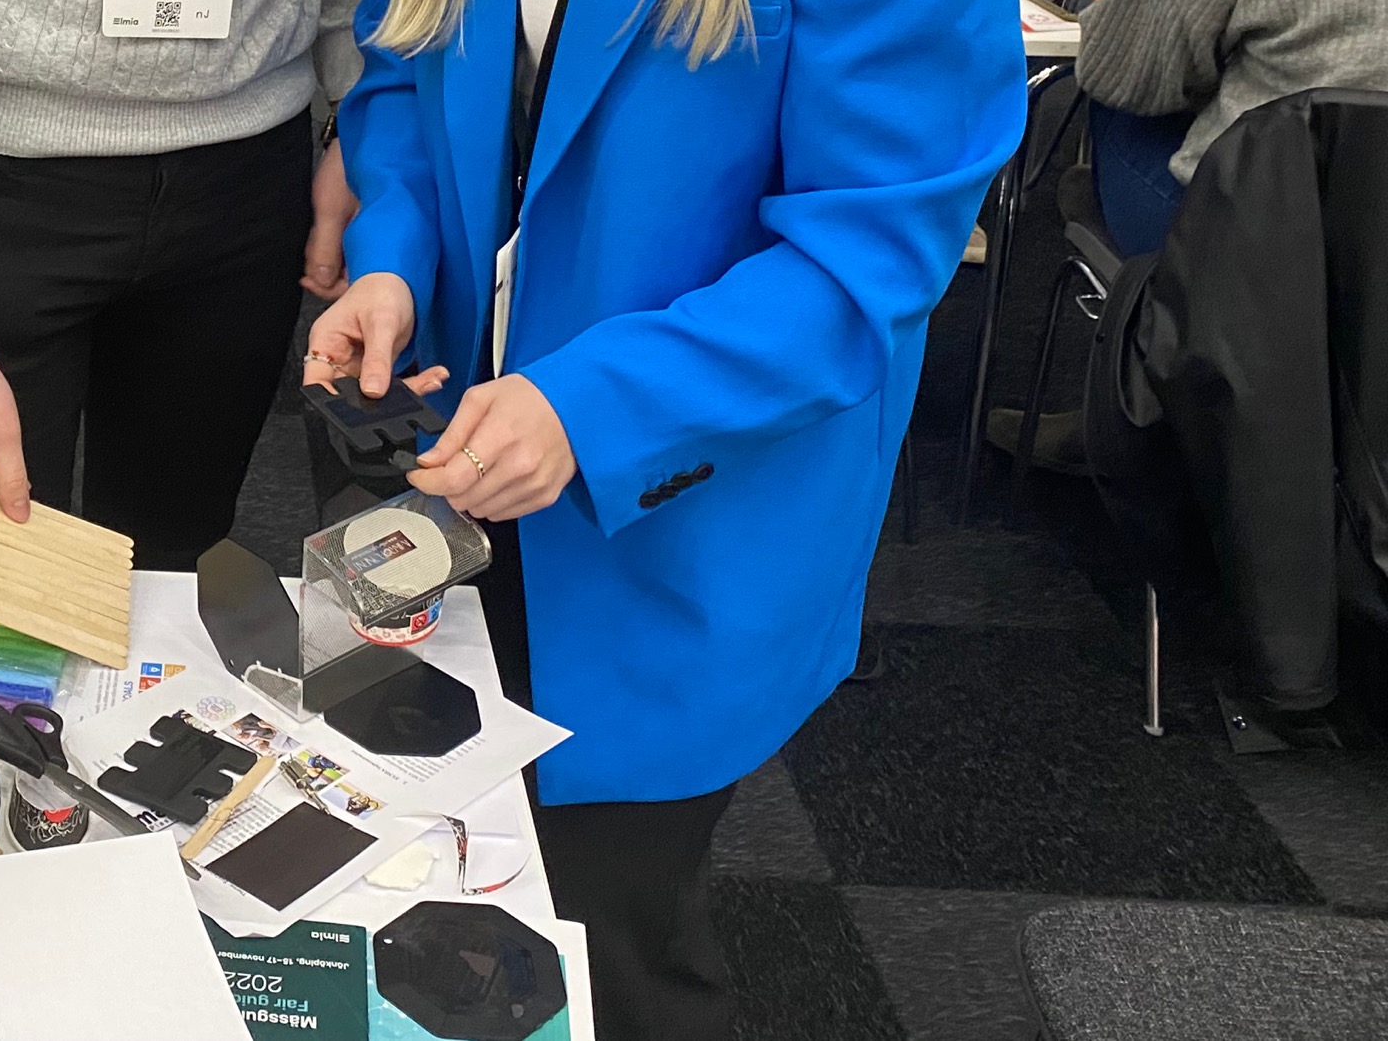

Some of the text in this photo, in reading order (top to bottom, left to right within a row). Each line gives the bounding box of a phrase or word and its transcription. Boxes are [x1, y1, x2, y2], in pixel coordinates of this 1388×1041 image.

[122, 680, 134, 702] OALS
[218, 951, 264, 962] november
[296, 958, 349, 970] Jönköping,
[274, 998, 309, 1012] Fair
